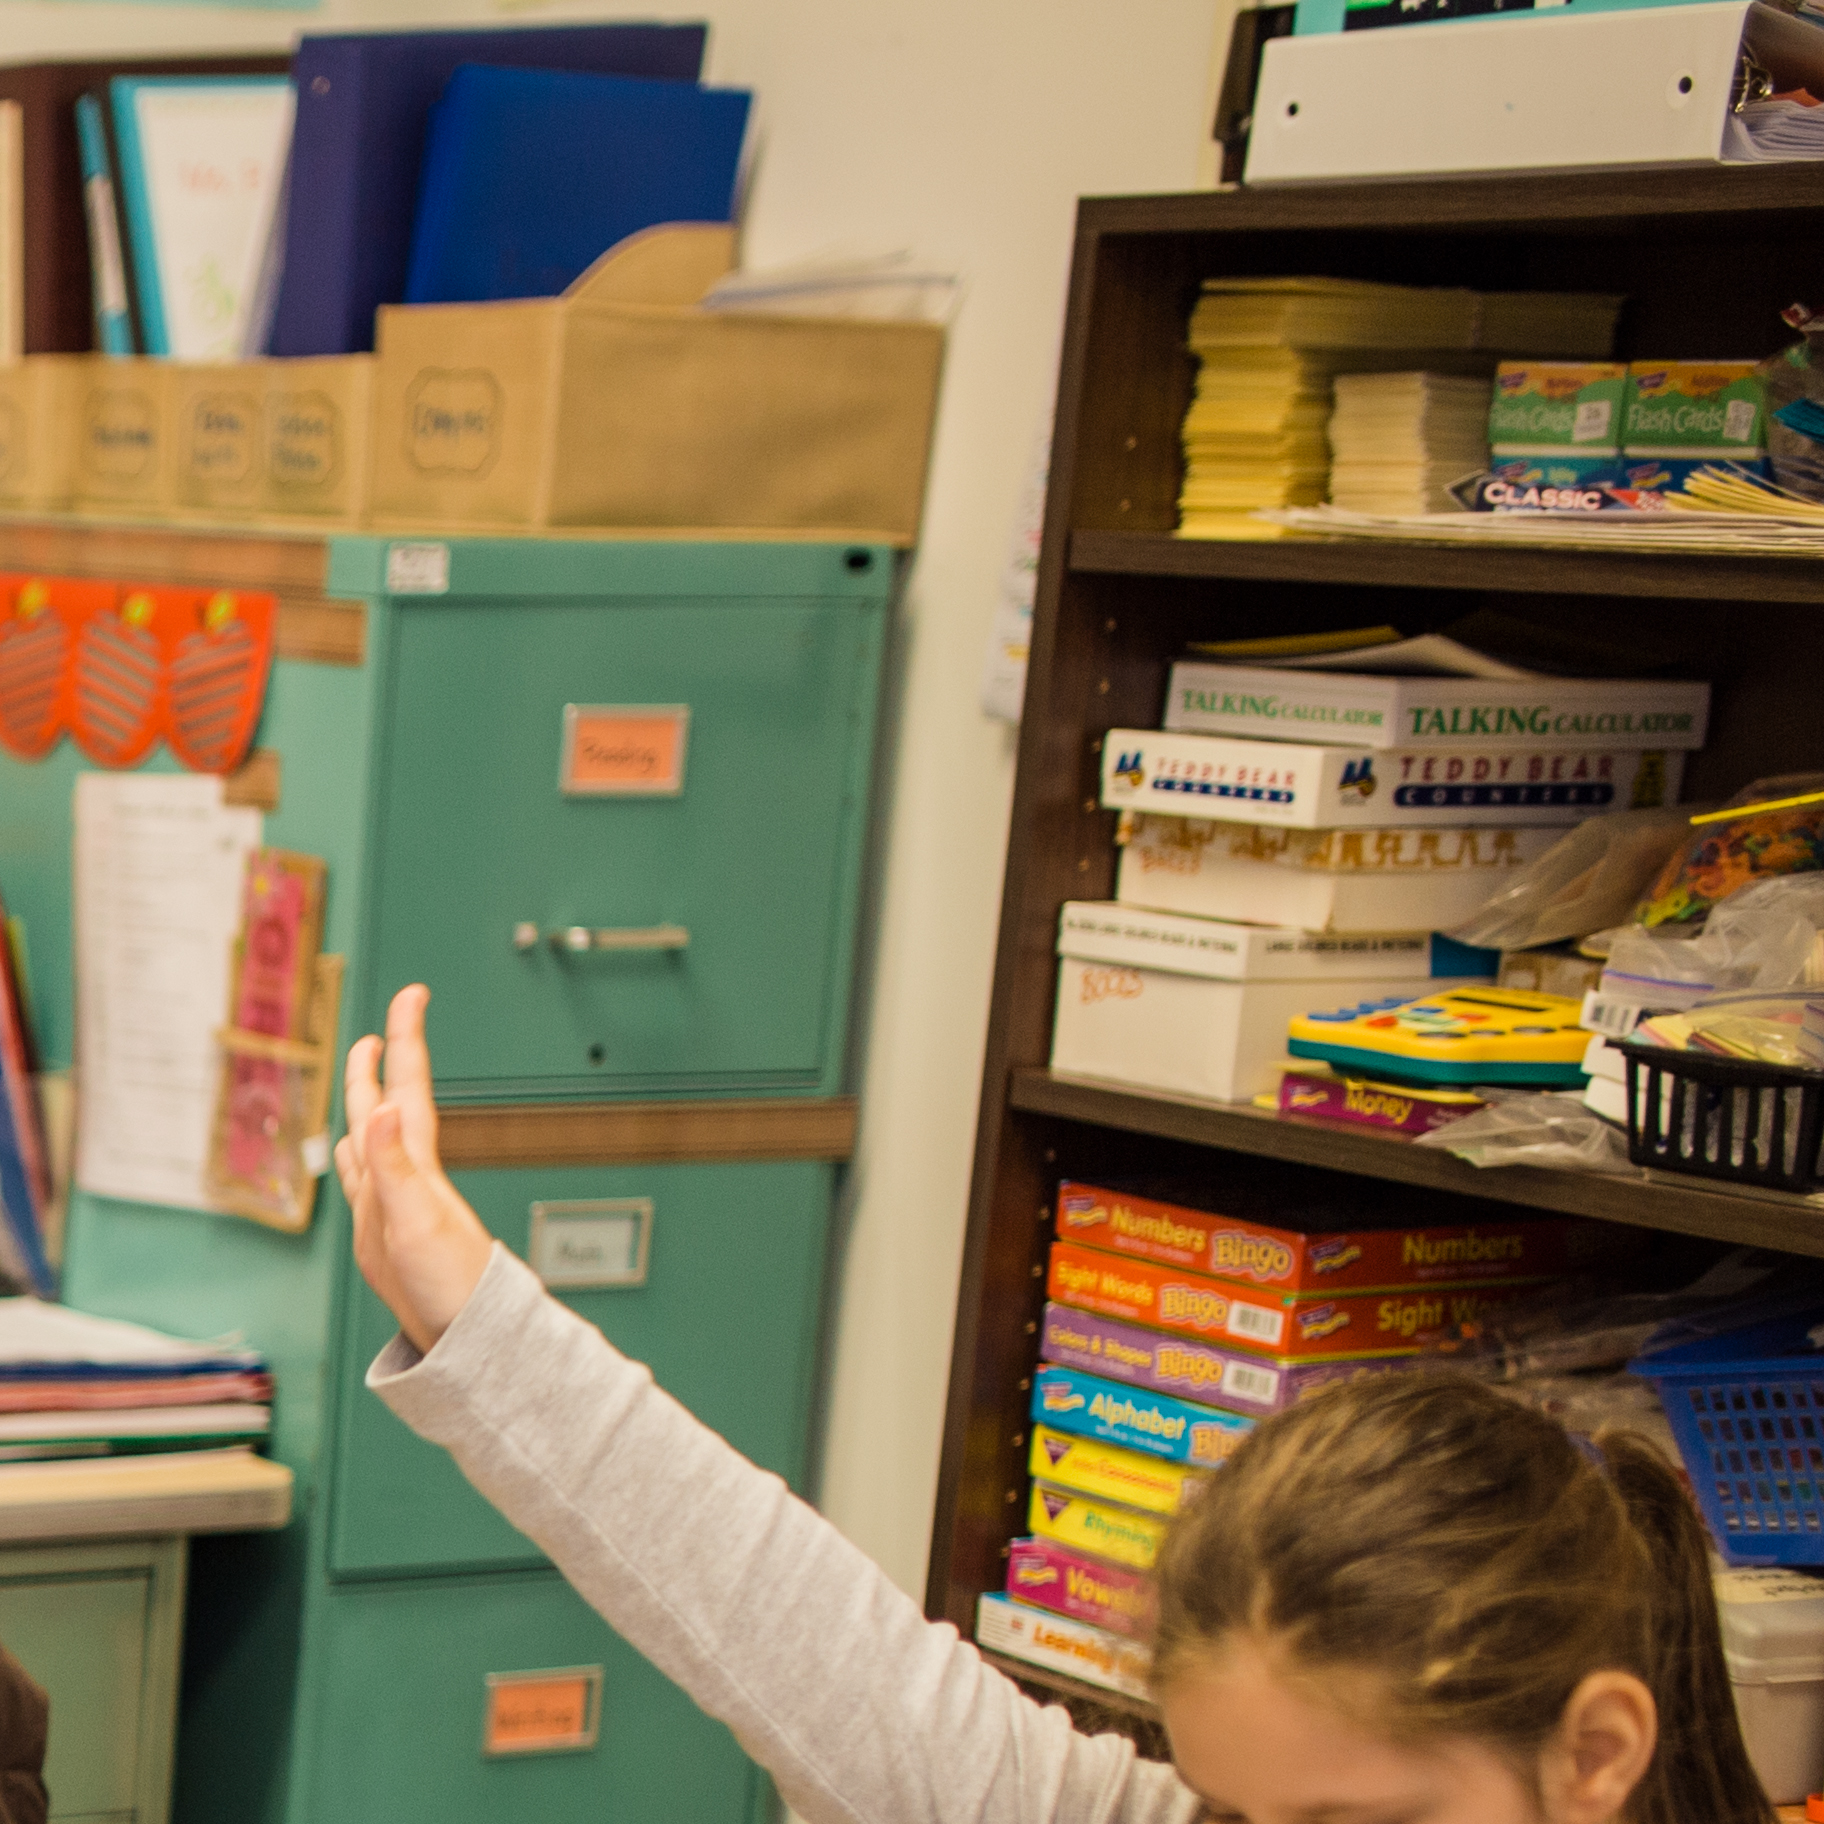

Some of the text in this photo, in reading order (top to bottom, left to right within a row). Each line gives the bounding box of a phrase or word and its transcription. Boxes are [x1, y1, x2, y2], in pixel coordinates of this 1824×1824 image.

[1483, 481, 1602, 511] CLASSIC
[1182, 688, 1384, 727] TALKING CALCULATOR
[1408, 705, 1694, 735] TALKING CALCULATOR
[1156, 755, 1296, 787] TEDDY BEAR
[1399, 755, 1614, 781] TEDDY BEAR
[1342, 1077, 1414, 1125] Money
[1109, 1204, 1208, 1252] Numbers
[1214, 1233, 1291, 1277] Bingo
[1402, 1228, 1524, 1264] Numbers
[1056, 1260, 1099, 1294] Sight
[1161, 1286, 1229, 1327] Bingo
[1377, 1297, 1445, 1337] Sight
[1156, 1349, 1224, 1385] Bingo
[1088, 1392, 1187, 1441] Alphabet
